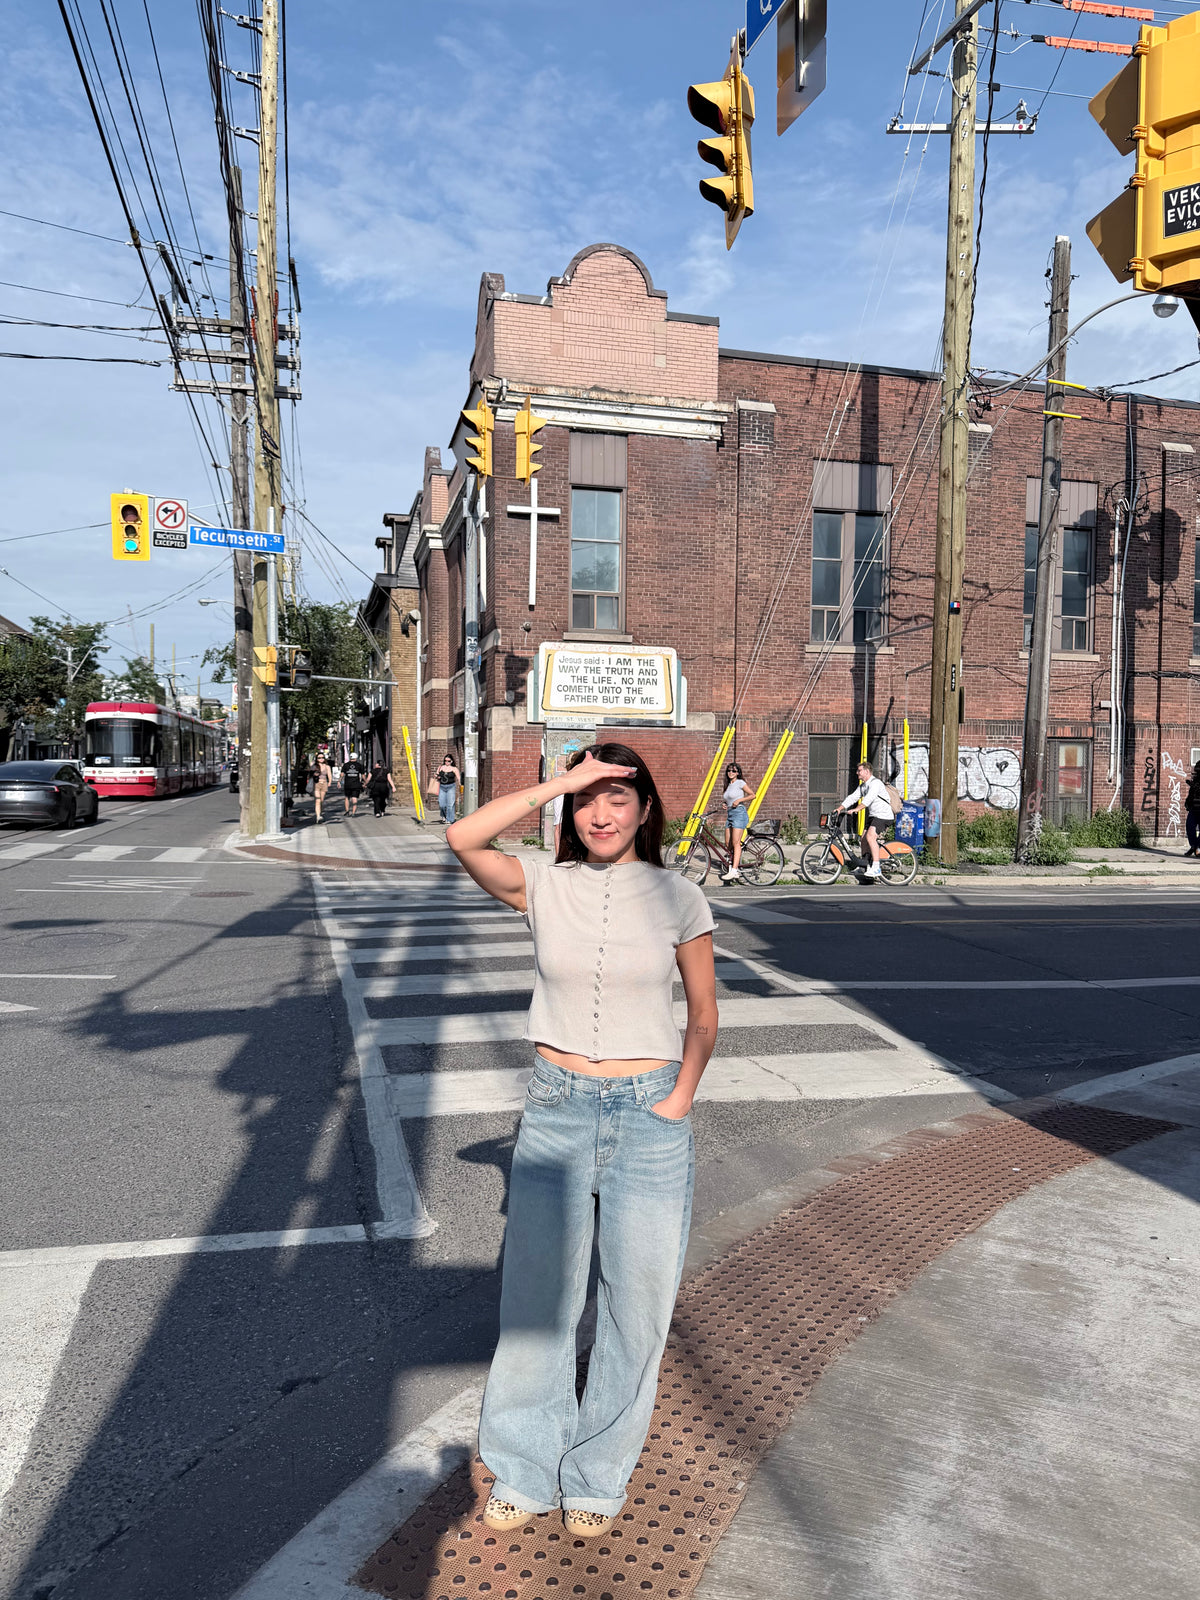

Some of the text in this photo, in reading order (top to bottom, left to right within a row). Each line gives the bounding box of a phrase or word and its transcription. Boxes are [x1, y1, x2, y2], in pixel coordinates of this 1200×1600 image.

[1184, 218, 1197, 229] '24
[194, 527, 268, 547] Tecumseth
[155, 539, 186, 548] EXCEPTED
[558, 656, 582, 664] Jesus
[616, 658, 632, 666] AM
[637, 659, 655, 667] THE
[558, 665, 658, 676] WAY THE TRUTH AND
[571, 675, 658, 686] THE LIFE. NO MAN
[556, 684, 643, 695] COMETH UNTO THE
[564, 694, 659, 705] FATHER BUT BY ME.
